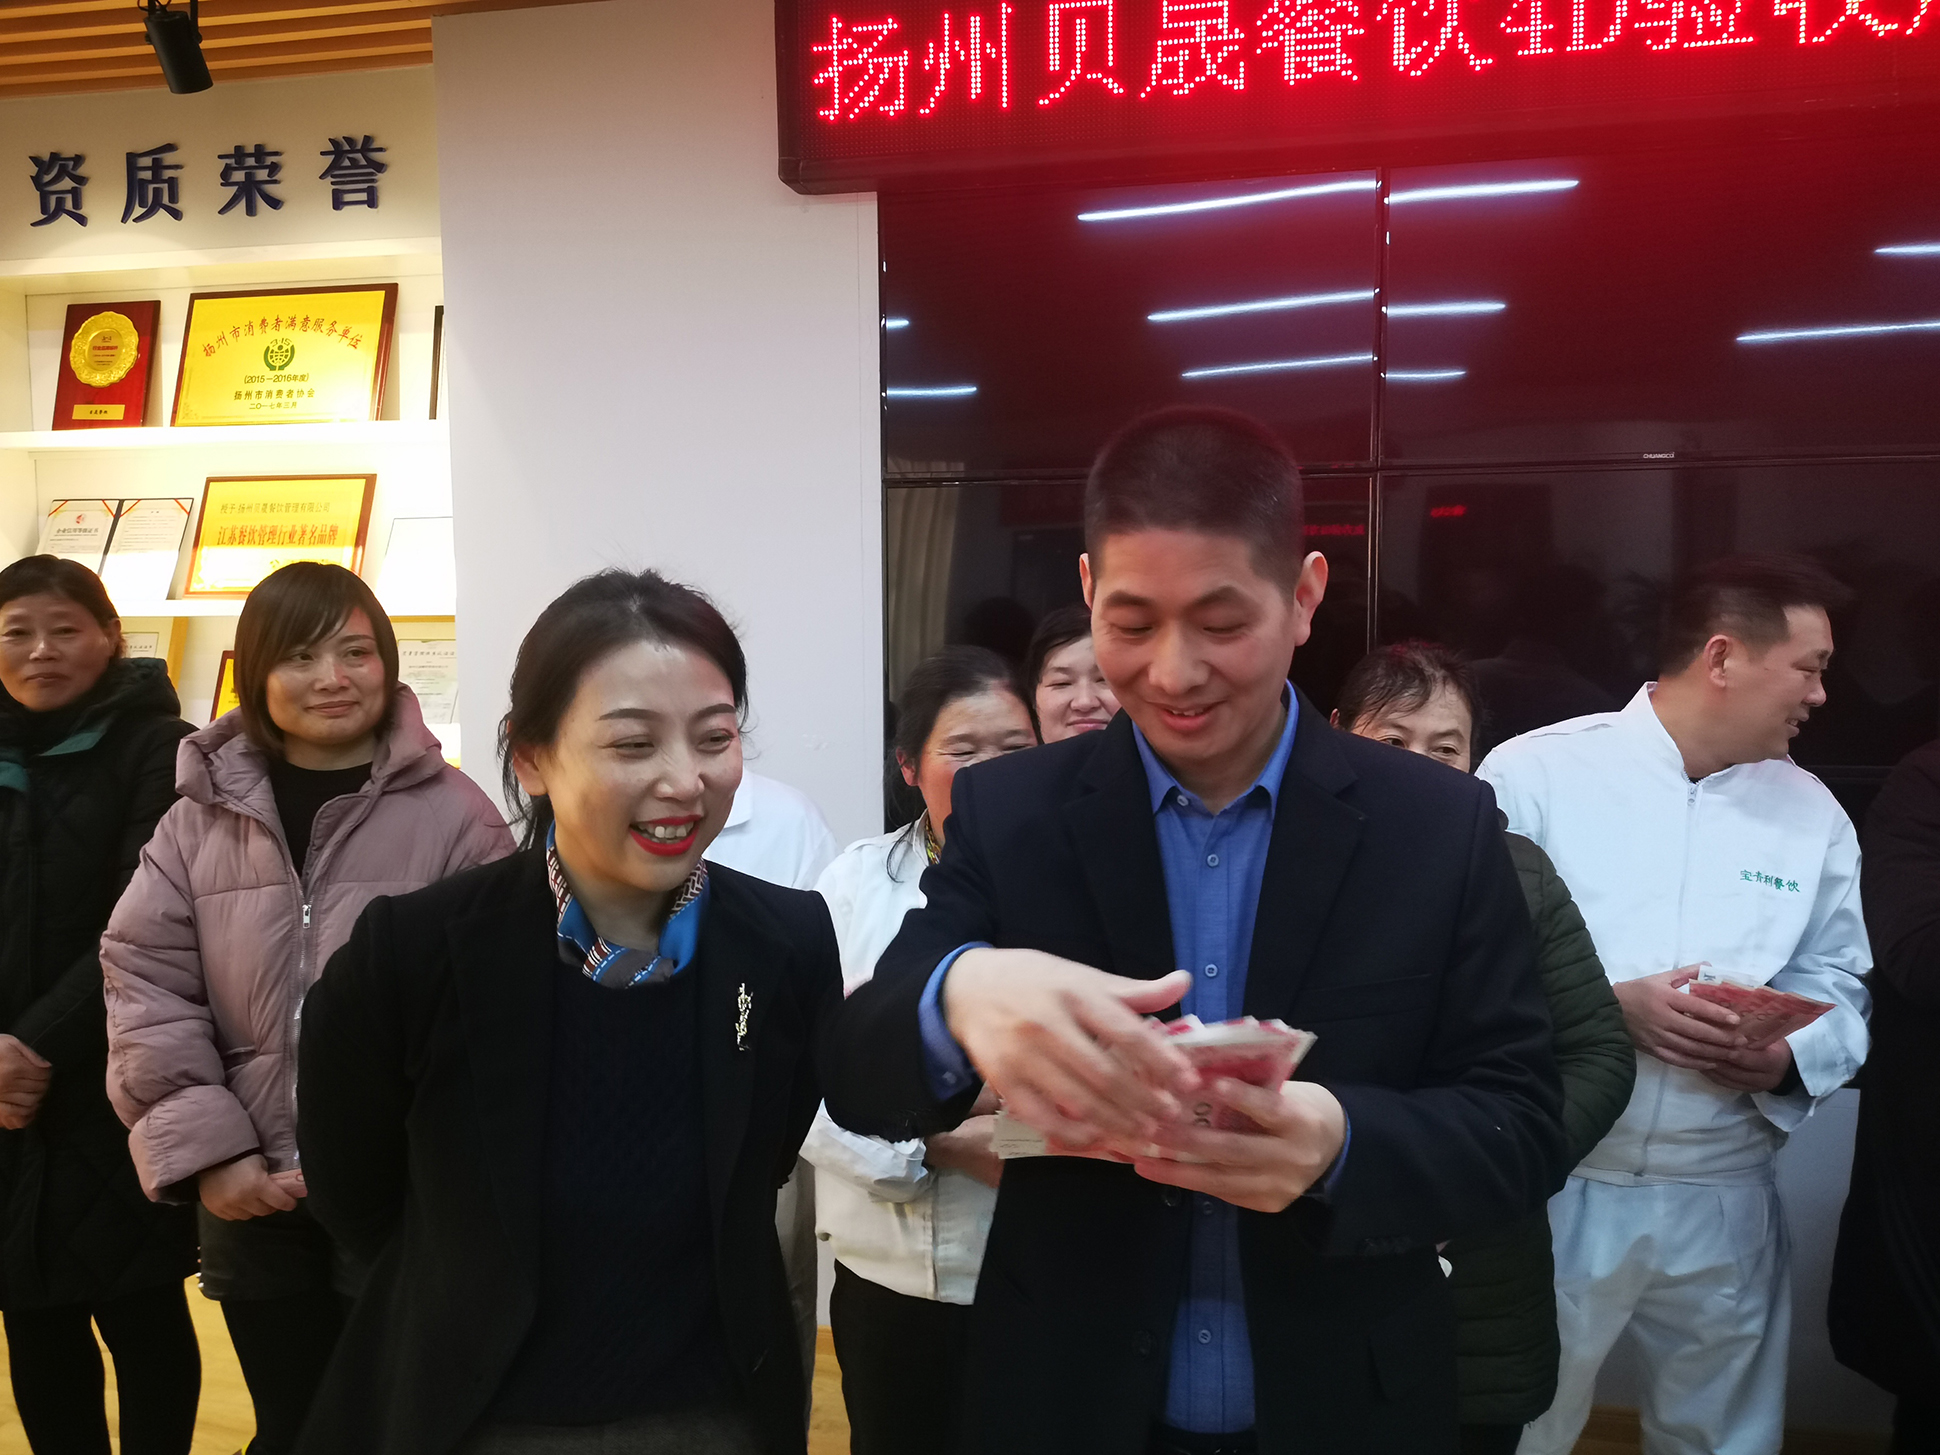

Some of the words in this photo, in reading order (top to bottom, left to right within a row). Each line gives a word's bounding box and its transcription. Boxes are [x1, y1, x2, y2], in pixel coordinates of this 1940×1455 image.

[28, 134, 388, 228] 资质荣誉
[203, 314, 364, 358] 扬州市消费者满意服务单位
[234, 387, 316, 401] 扬州市消费者协会
[216, 523, 340, 546] 江苏餐饮管理行业著名品牌
